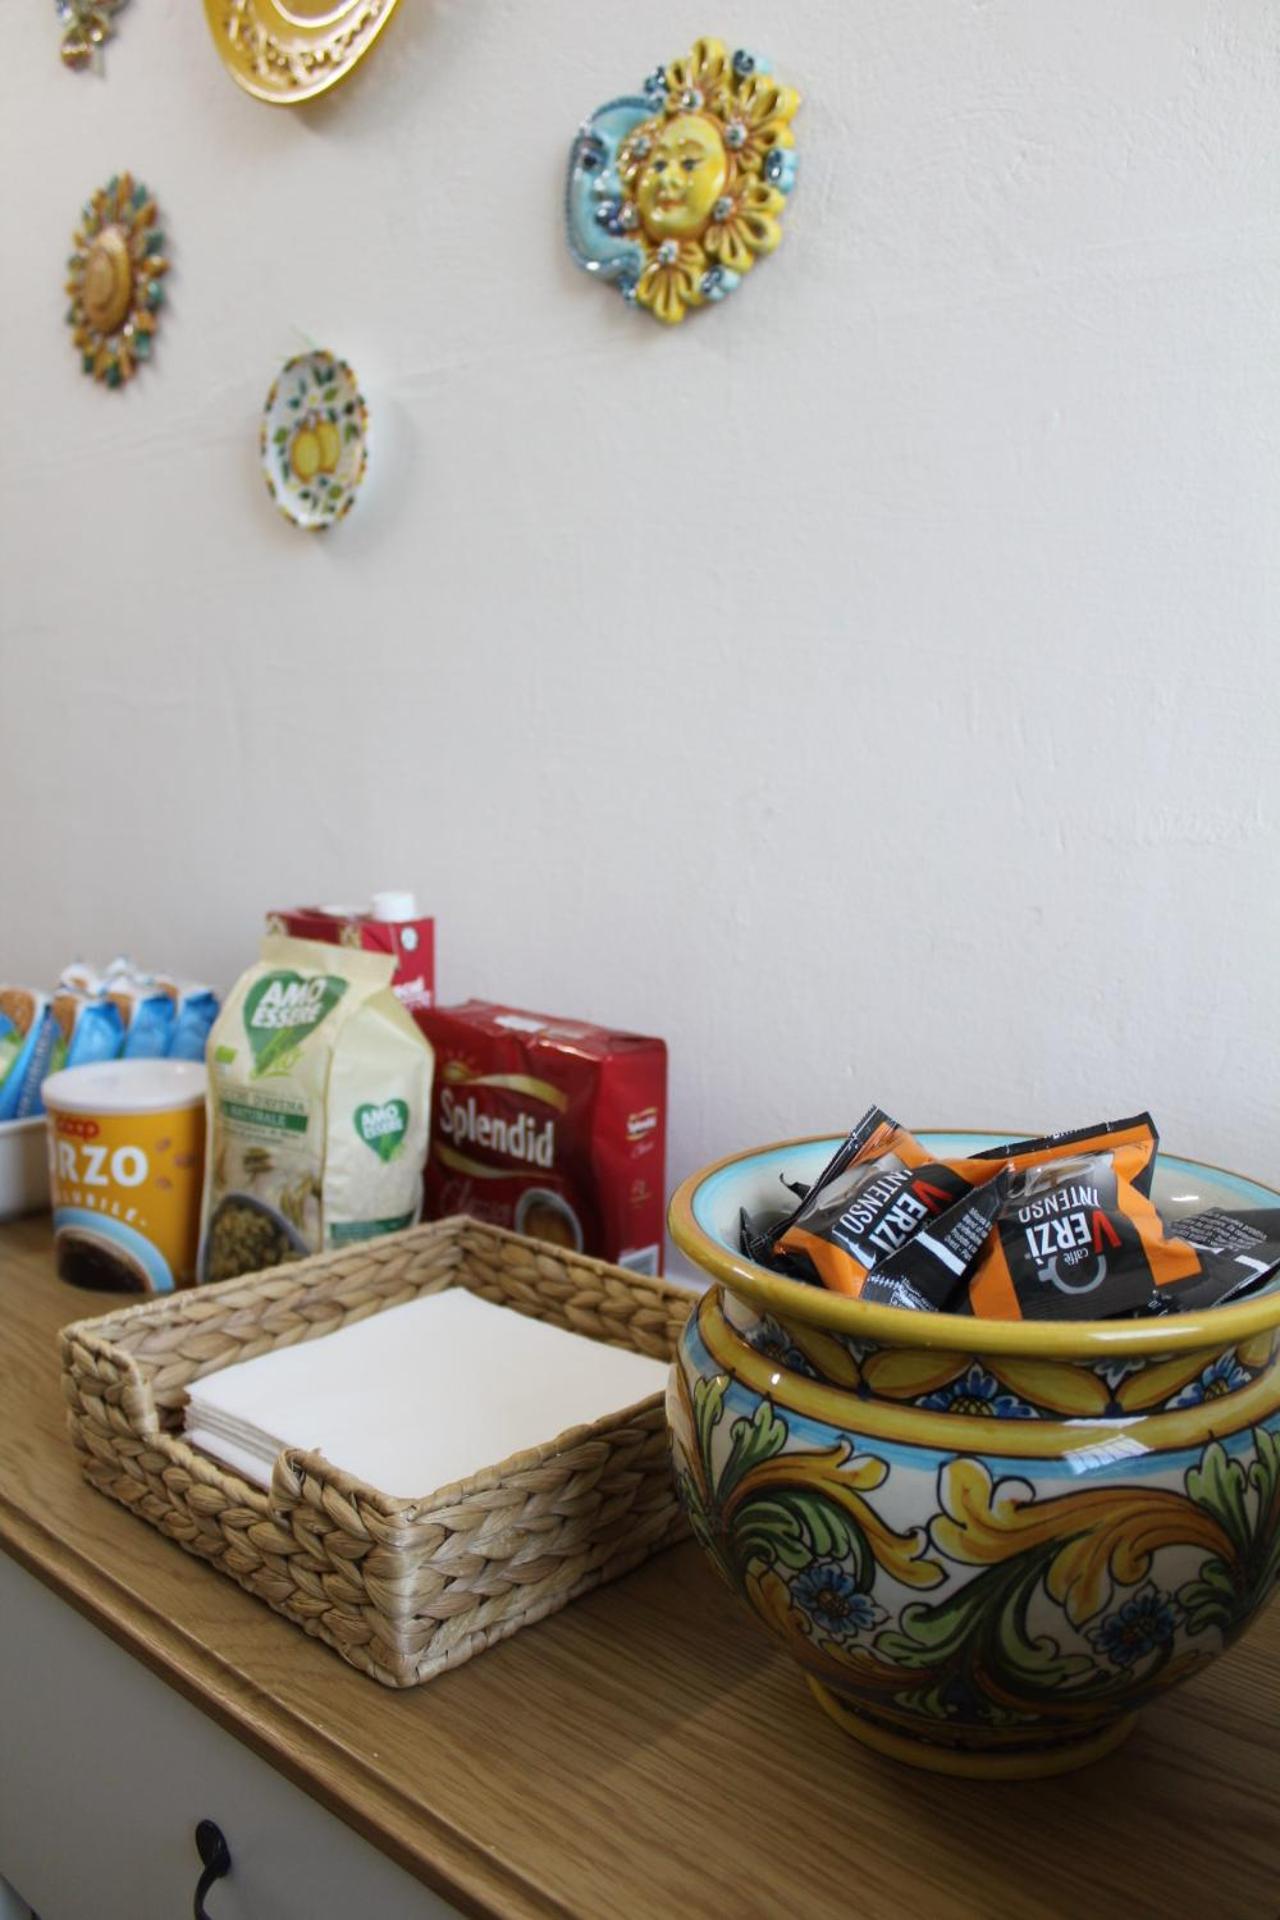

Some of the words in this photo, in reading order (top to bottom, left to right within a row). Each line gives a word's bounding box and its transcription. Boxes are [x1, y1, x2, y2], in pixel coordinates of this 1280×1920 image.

[260, 978, 327, 1006] AMO
[439, 1086, 554, 1169] Splendid
[54, 1143, 148, 1187] RZO
[839, 1169, 914, 1236] INTENSO
[1019, 1184, 1102, 1223] INTENSO
[1063, 1247, 1089, 1266] caffè
